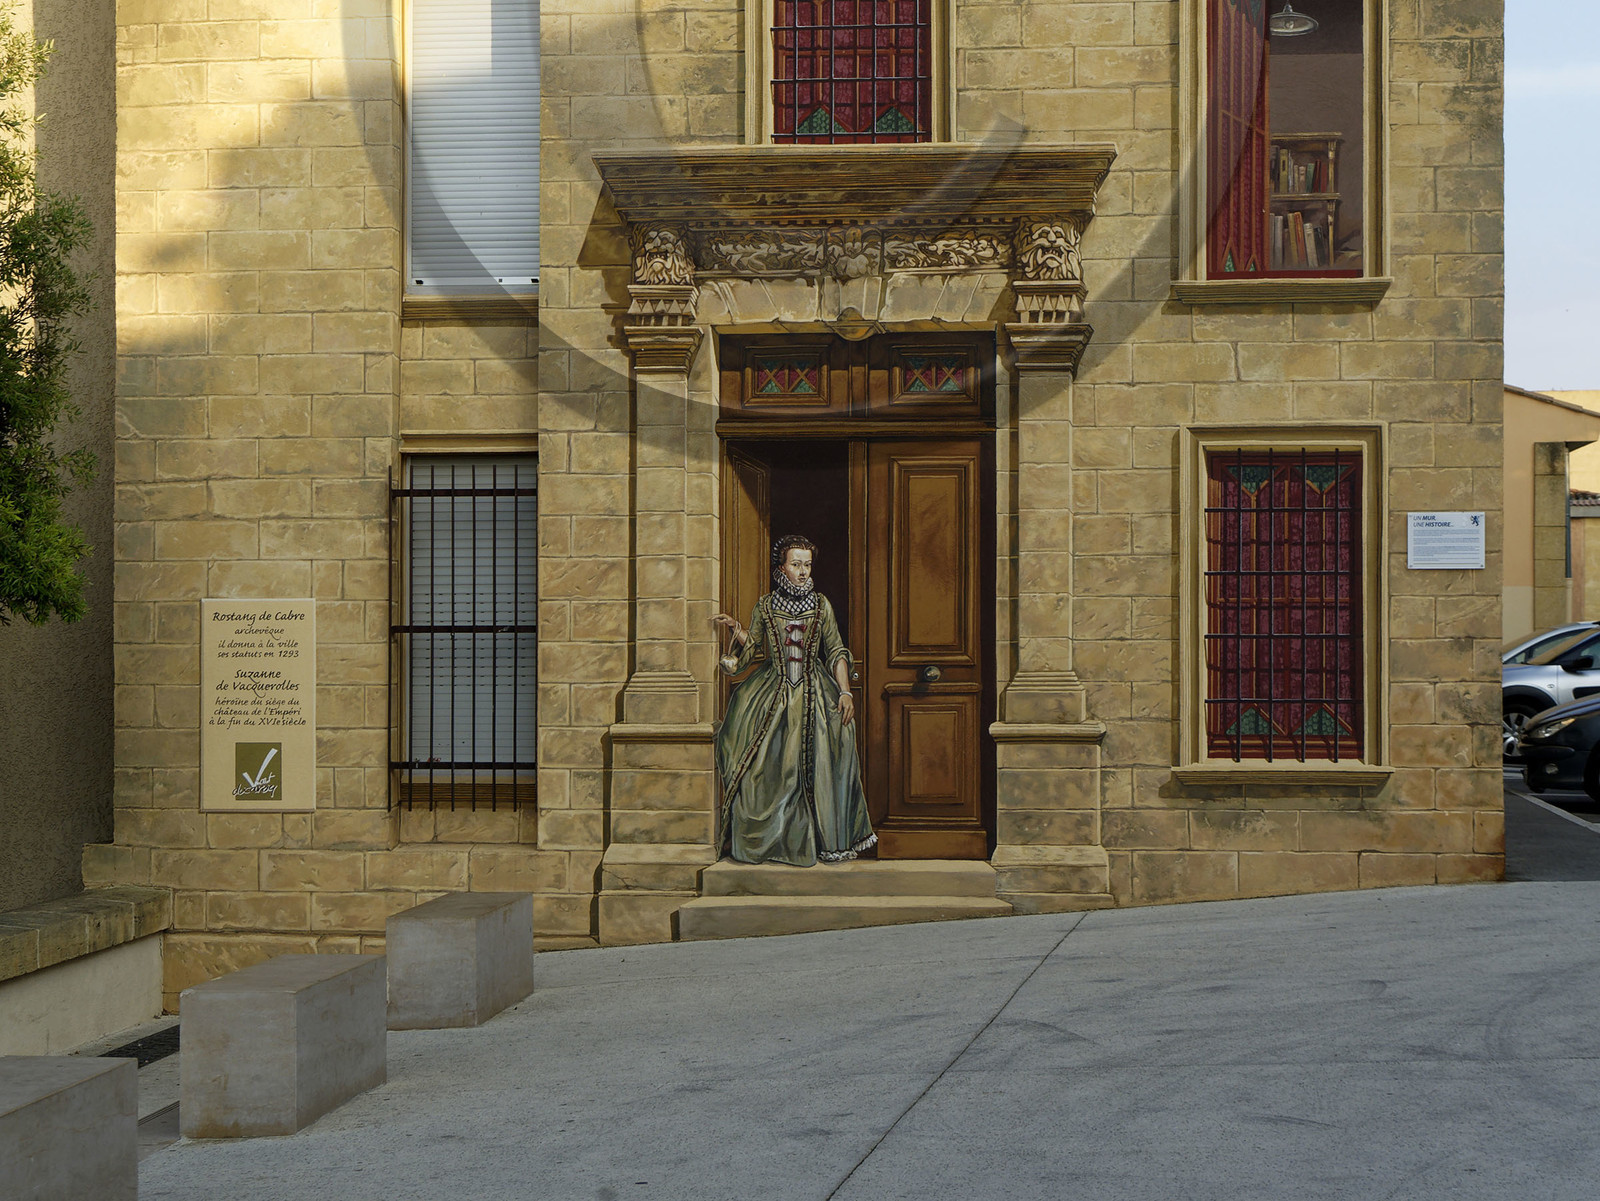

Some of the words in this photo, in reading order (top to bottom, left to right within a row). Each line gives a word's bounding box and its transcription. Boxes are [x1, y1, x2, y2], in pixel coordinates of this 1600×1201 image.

[212, 611, 257, 626] Rostang
[258, 610, 272, 621] de
[275, 609, 305, 621] Cabre
[218, 640, 226, 649] il
[227, 639, 256, 649] donna
[266, 639, 275, 649] la
[277, 639, 299, 649] ville
[231, 650, 262, 658] statuts
[278, 650, 300, 658] 1293
[234, 669, 282, 684] Suzanne
[215, 679, 229, 691] de
[232, 679, 300, 699] Vacquerolles
[215, 696, 249, 706] héroïne
[250, 696, 263, 706] du
[265, 697, 286, 709] siège
[287, 697, 300, 706] du
[213, 706, 249, 716] château
[251, 706, 263, 716] de
[216, 716, 226, 726] la
[226, 716, 241, 730] fin
[243, 718, 256, 726] du
